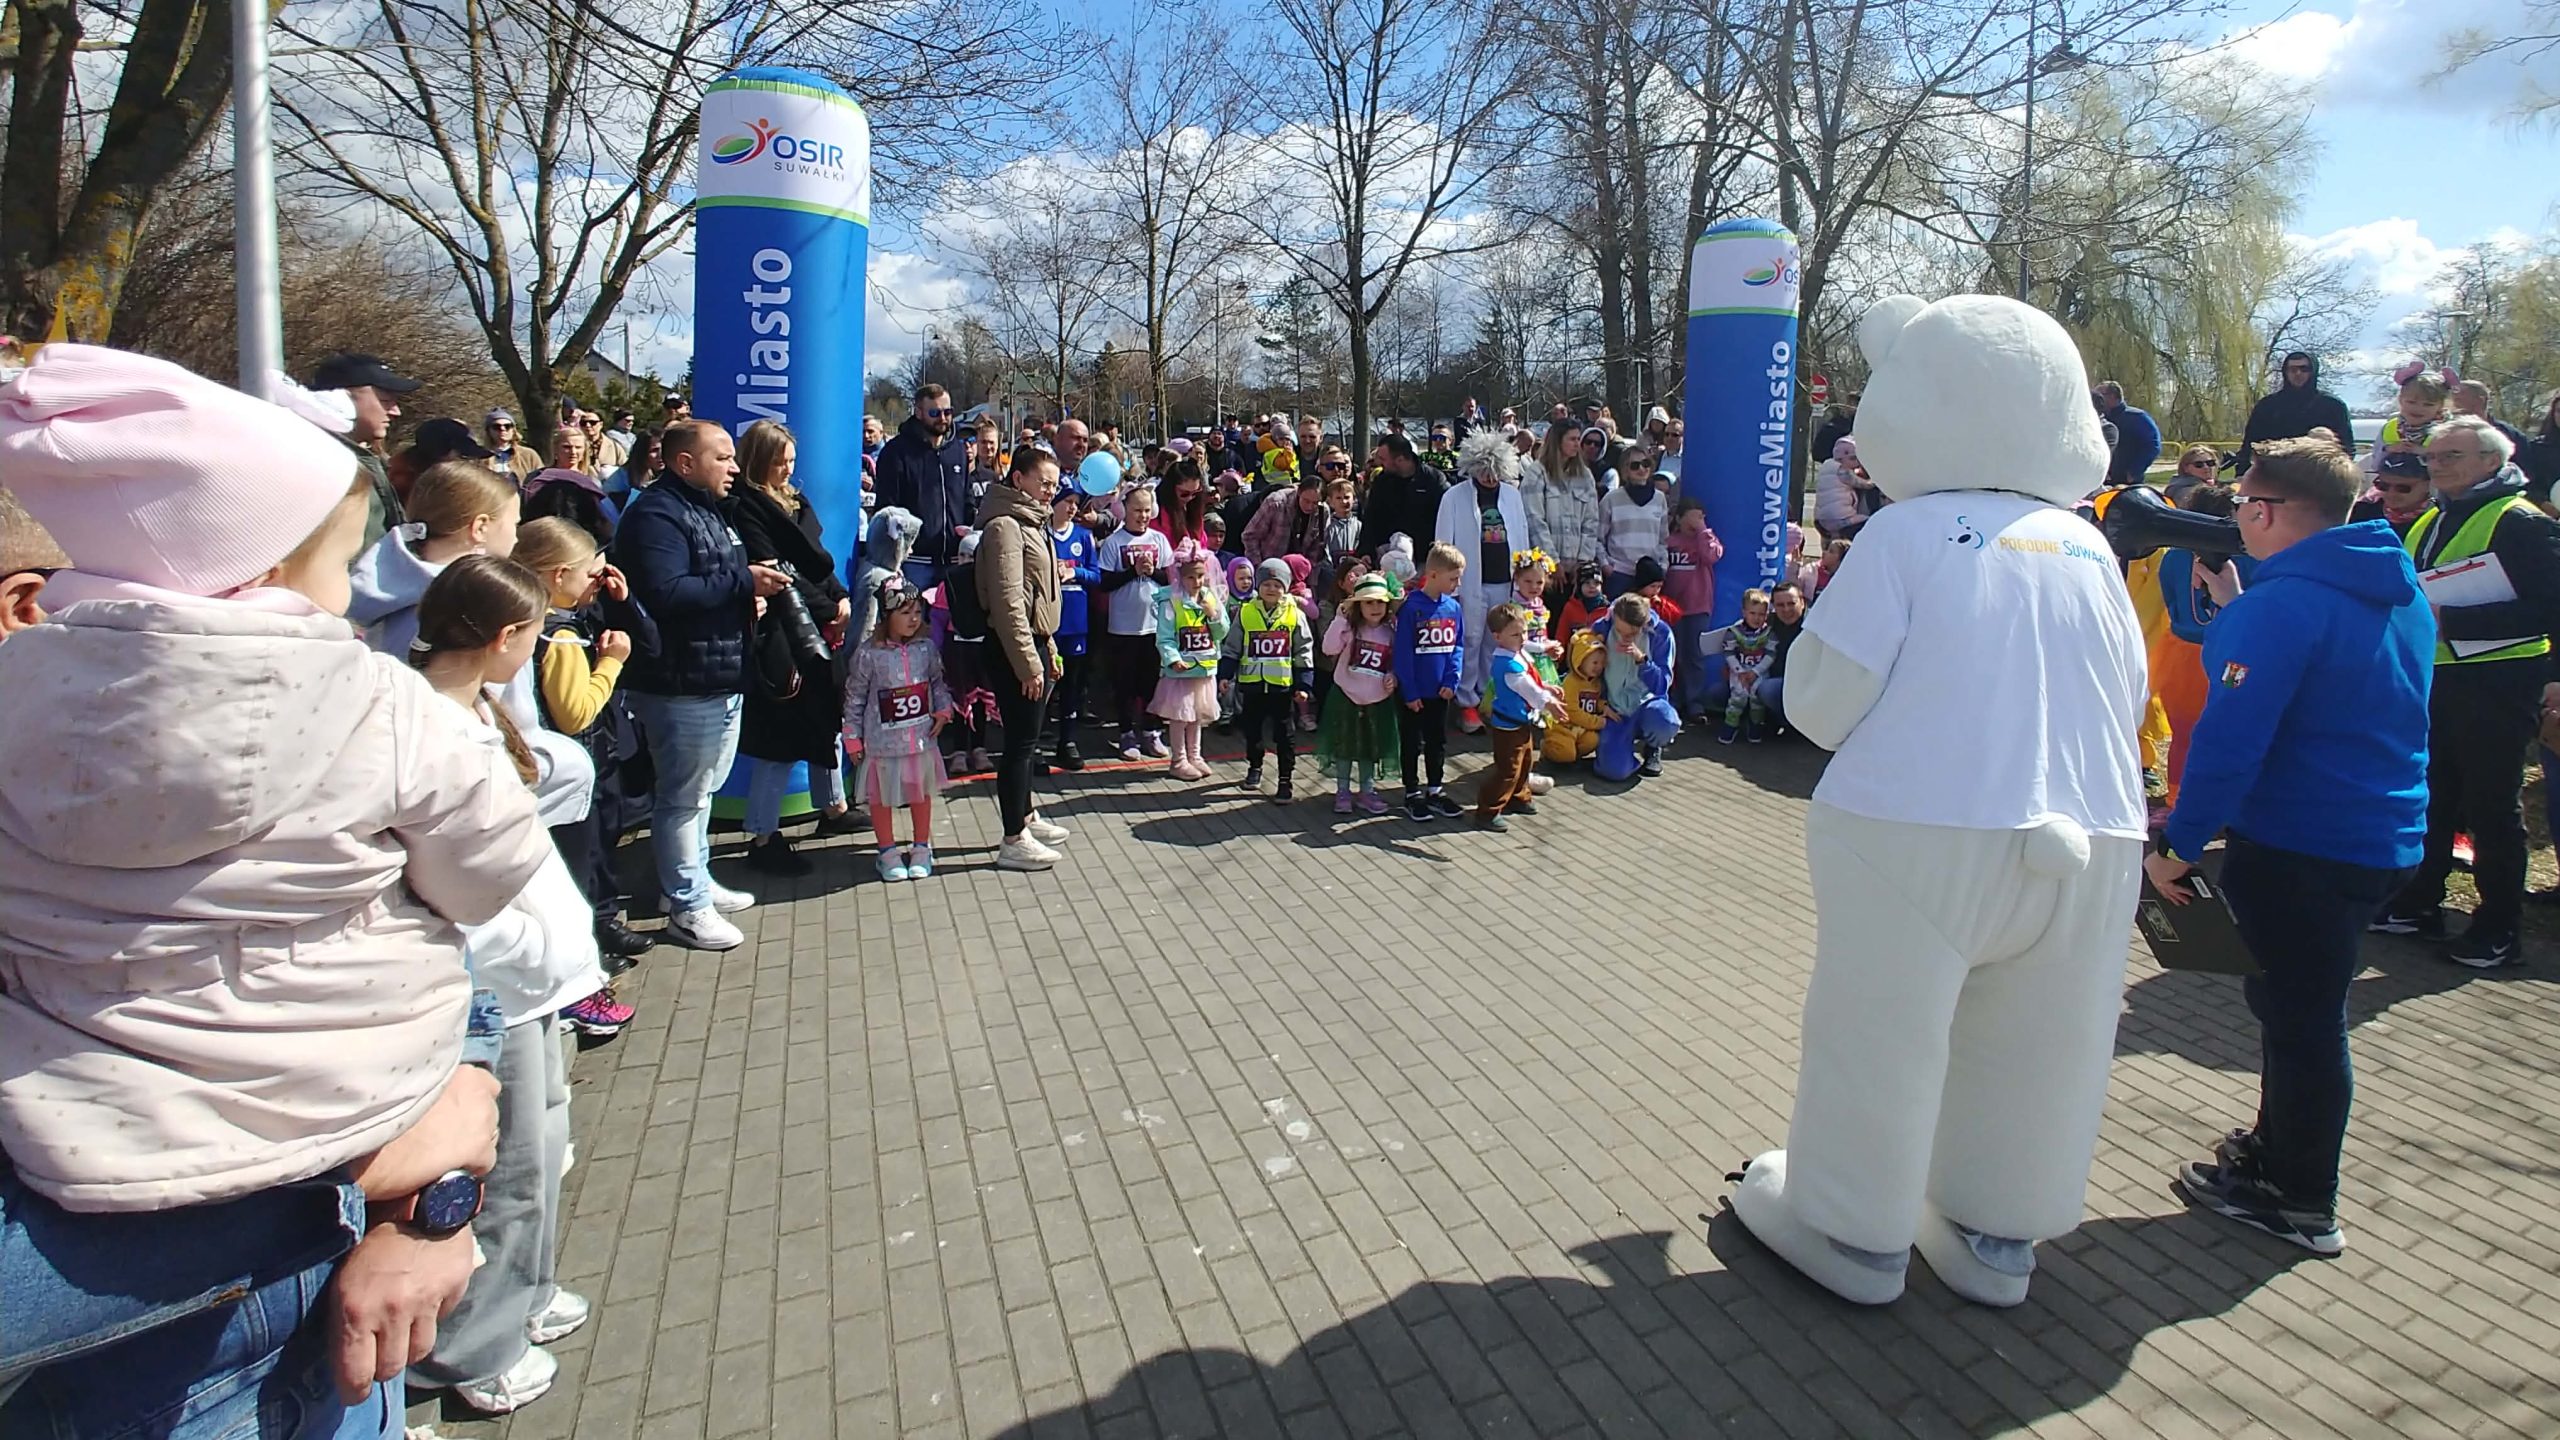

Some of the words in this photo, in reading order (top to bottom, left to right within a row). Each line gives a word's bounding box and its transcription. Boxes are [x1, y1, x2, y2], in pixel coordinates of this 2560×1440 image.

[773, 135, 844, 170] OSIR
[774, 161, 845, 182] SUWAŁKI
[1670, 552, 1689, 564] 112
[1185, 633, 1210, 648] 133
[1418, 627, 1454, 645] 200
[1253, 638, 1286, 655] 107
[1360, 648, 1382, 668] 75
[893, 695, 921, 717] 39
